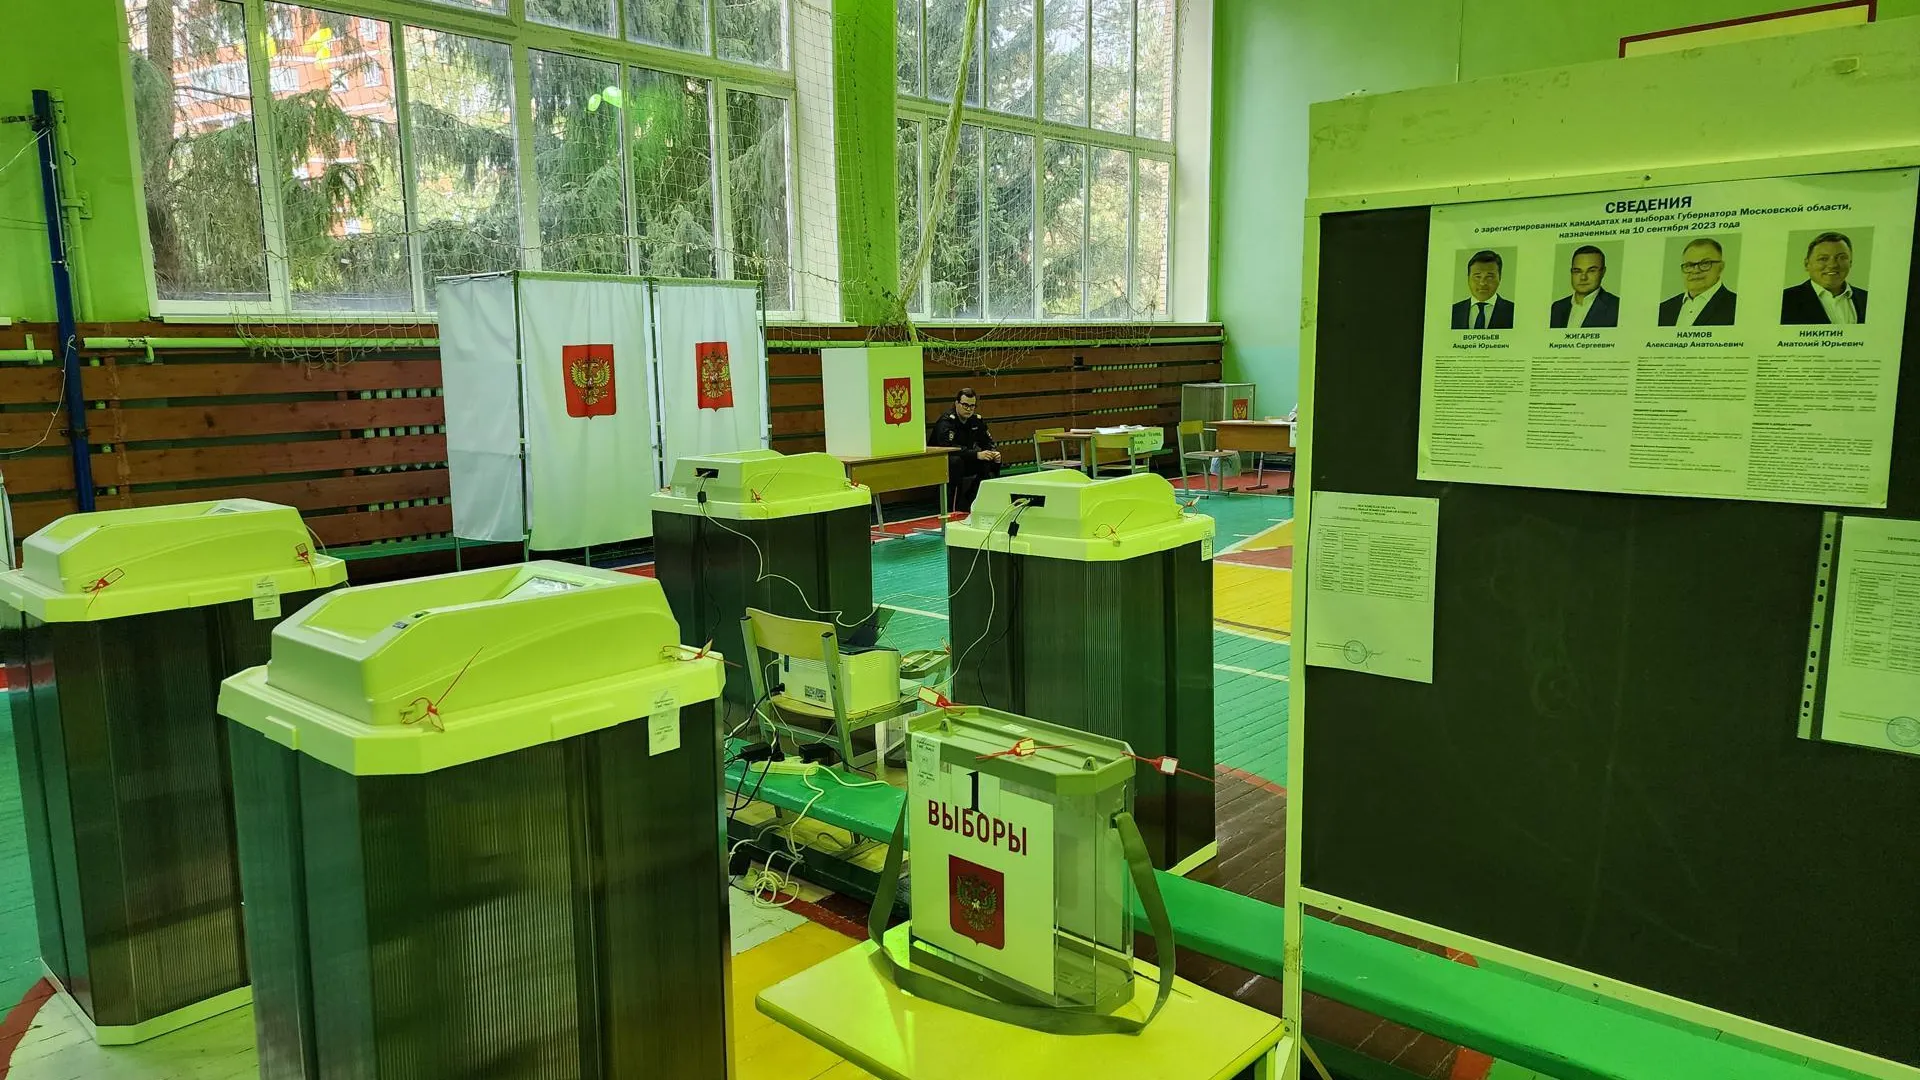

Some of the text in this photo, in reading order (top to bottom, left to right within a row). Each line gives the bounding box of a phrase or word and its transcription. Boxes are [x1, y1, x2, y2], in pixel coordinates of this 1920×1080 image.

[1605, 196, 1692, 214] СВЕДЕНИЯ
[1481, 220, 1568, 233] зарегистрированных
[1569, 217, 1620, 228] кандидатах
[1621, 216, 1634, 225] на
[1635, 213, 1675, 224] выборах
[1677, 209, 1737, 221] Губернатора
[1740, 204, 1804, 217] Московской
[1806, 202, 1852, 213] области,
[1559, 220, 1741, 239] назначенных на 10 сентября 2023 года
[1564, 332, 1601, 340] ЖИГАРЕВ
[1676, 331, 1713, 339] НАУМОВ
[1799, 330, 1844, 338] НИКИТИН
[1452, 342, 1510, 350] Андрей Юрьевич
[1549, 341, 1615, 350] Кирилл Сергеевич
[1646, 341, 1744, 349] Александр Анатольевич
[1777, 340, 1864, 349] Анатолий Юрьевич
[966, 771, 981, 813] 1
[928, 799, 1028, 857] ВЫБОРЫ
